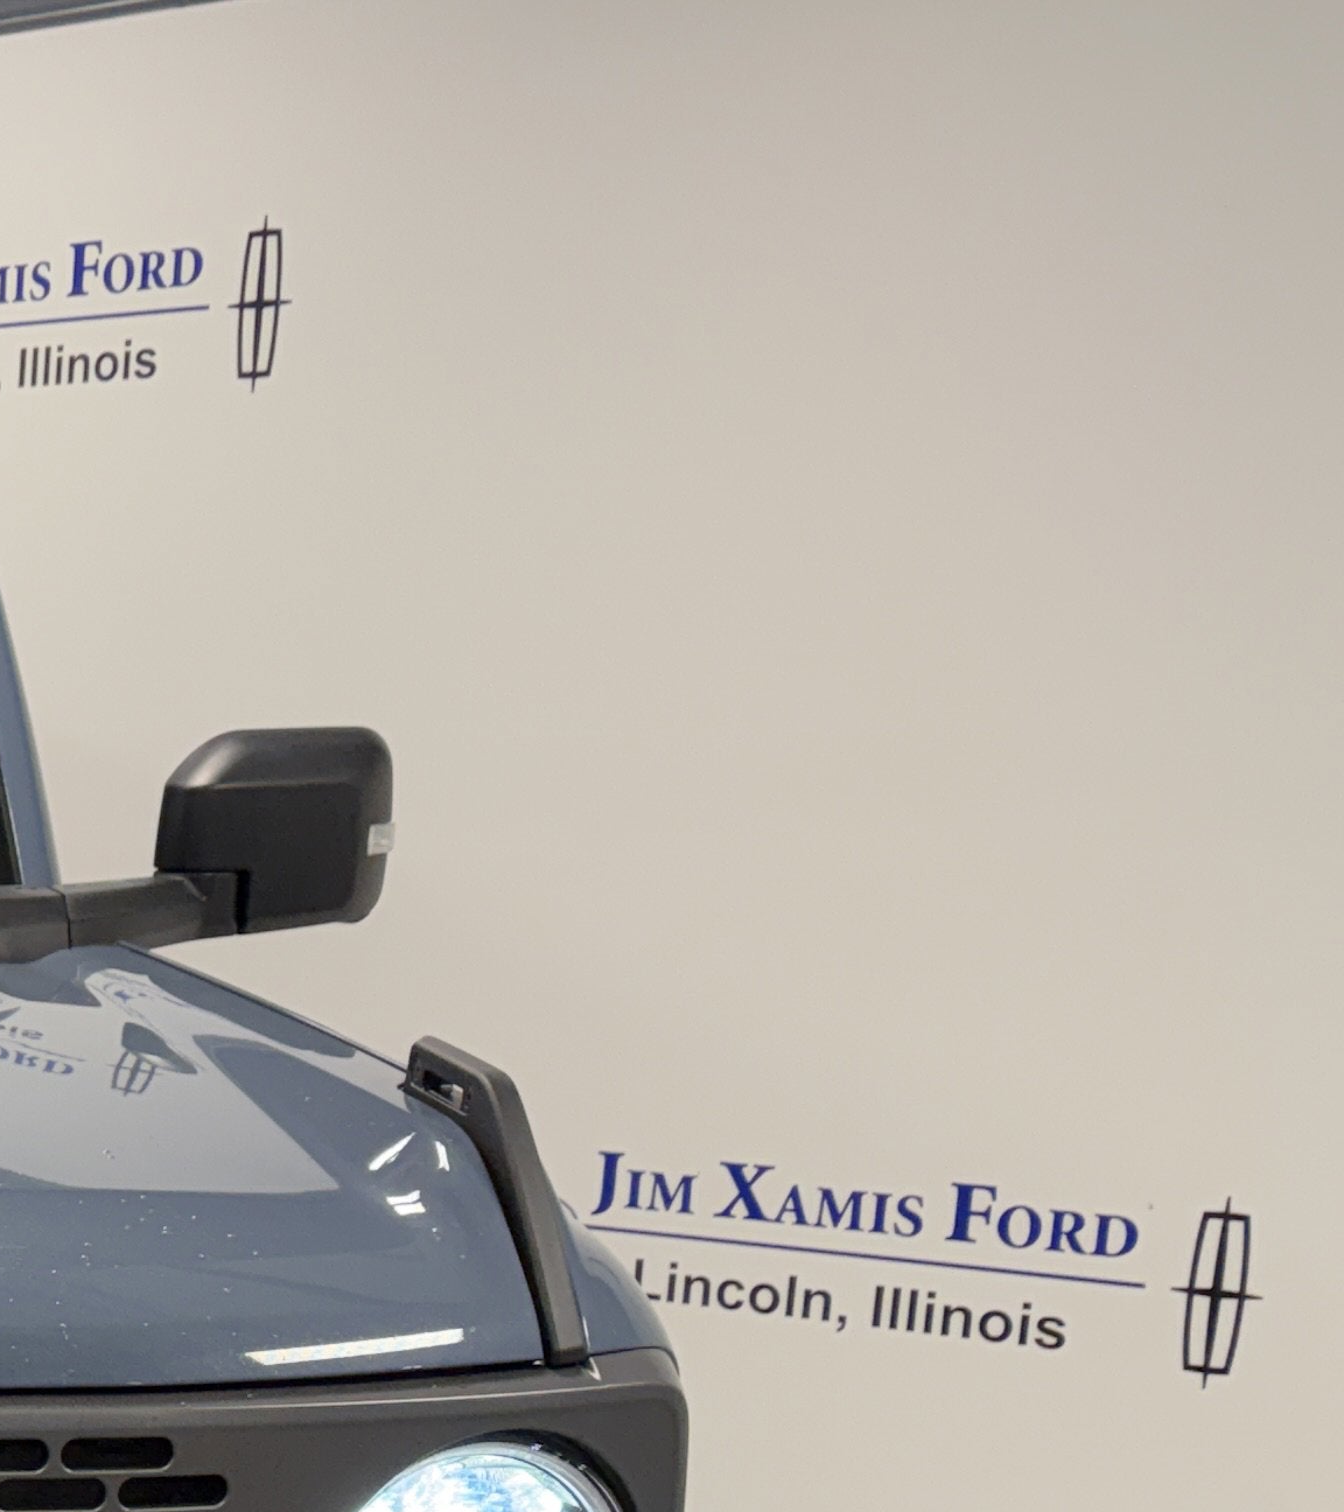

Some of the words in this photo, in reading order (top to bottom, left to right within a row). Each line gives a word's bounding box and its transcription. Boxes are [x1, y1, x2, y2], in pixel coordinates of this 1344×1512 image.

[68, 240, 204, 298] FORD
[18, 339, 157, 389] Illinois
[590, 1150, 697, 1216] JIM
[715, 1161, 924, 1238] XAMIS
[945, 1181, 1139, 1258] FORD
[870, 1285, 1067, 1350] Illinois
